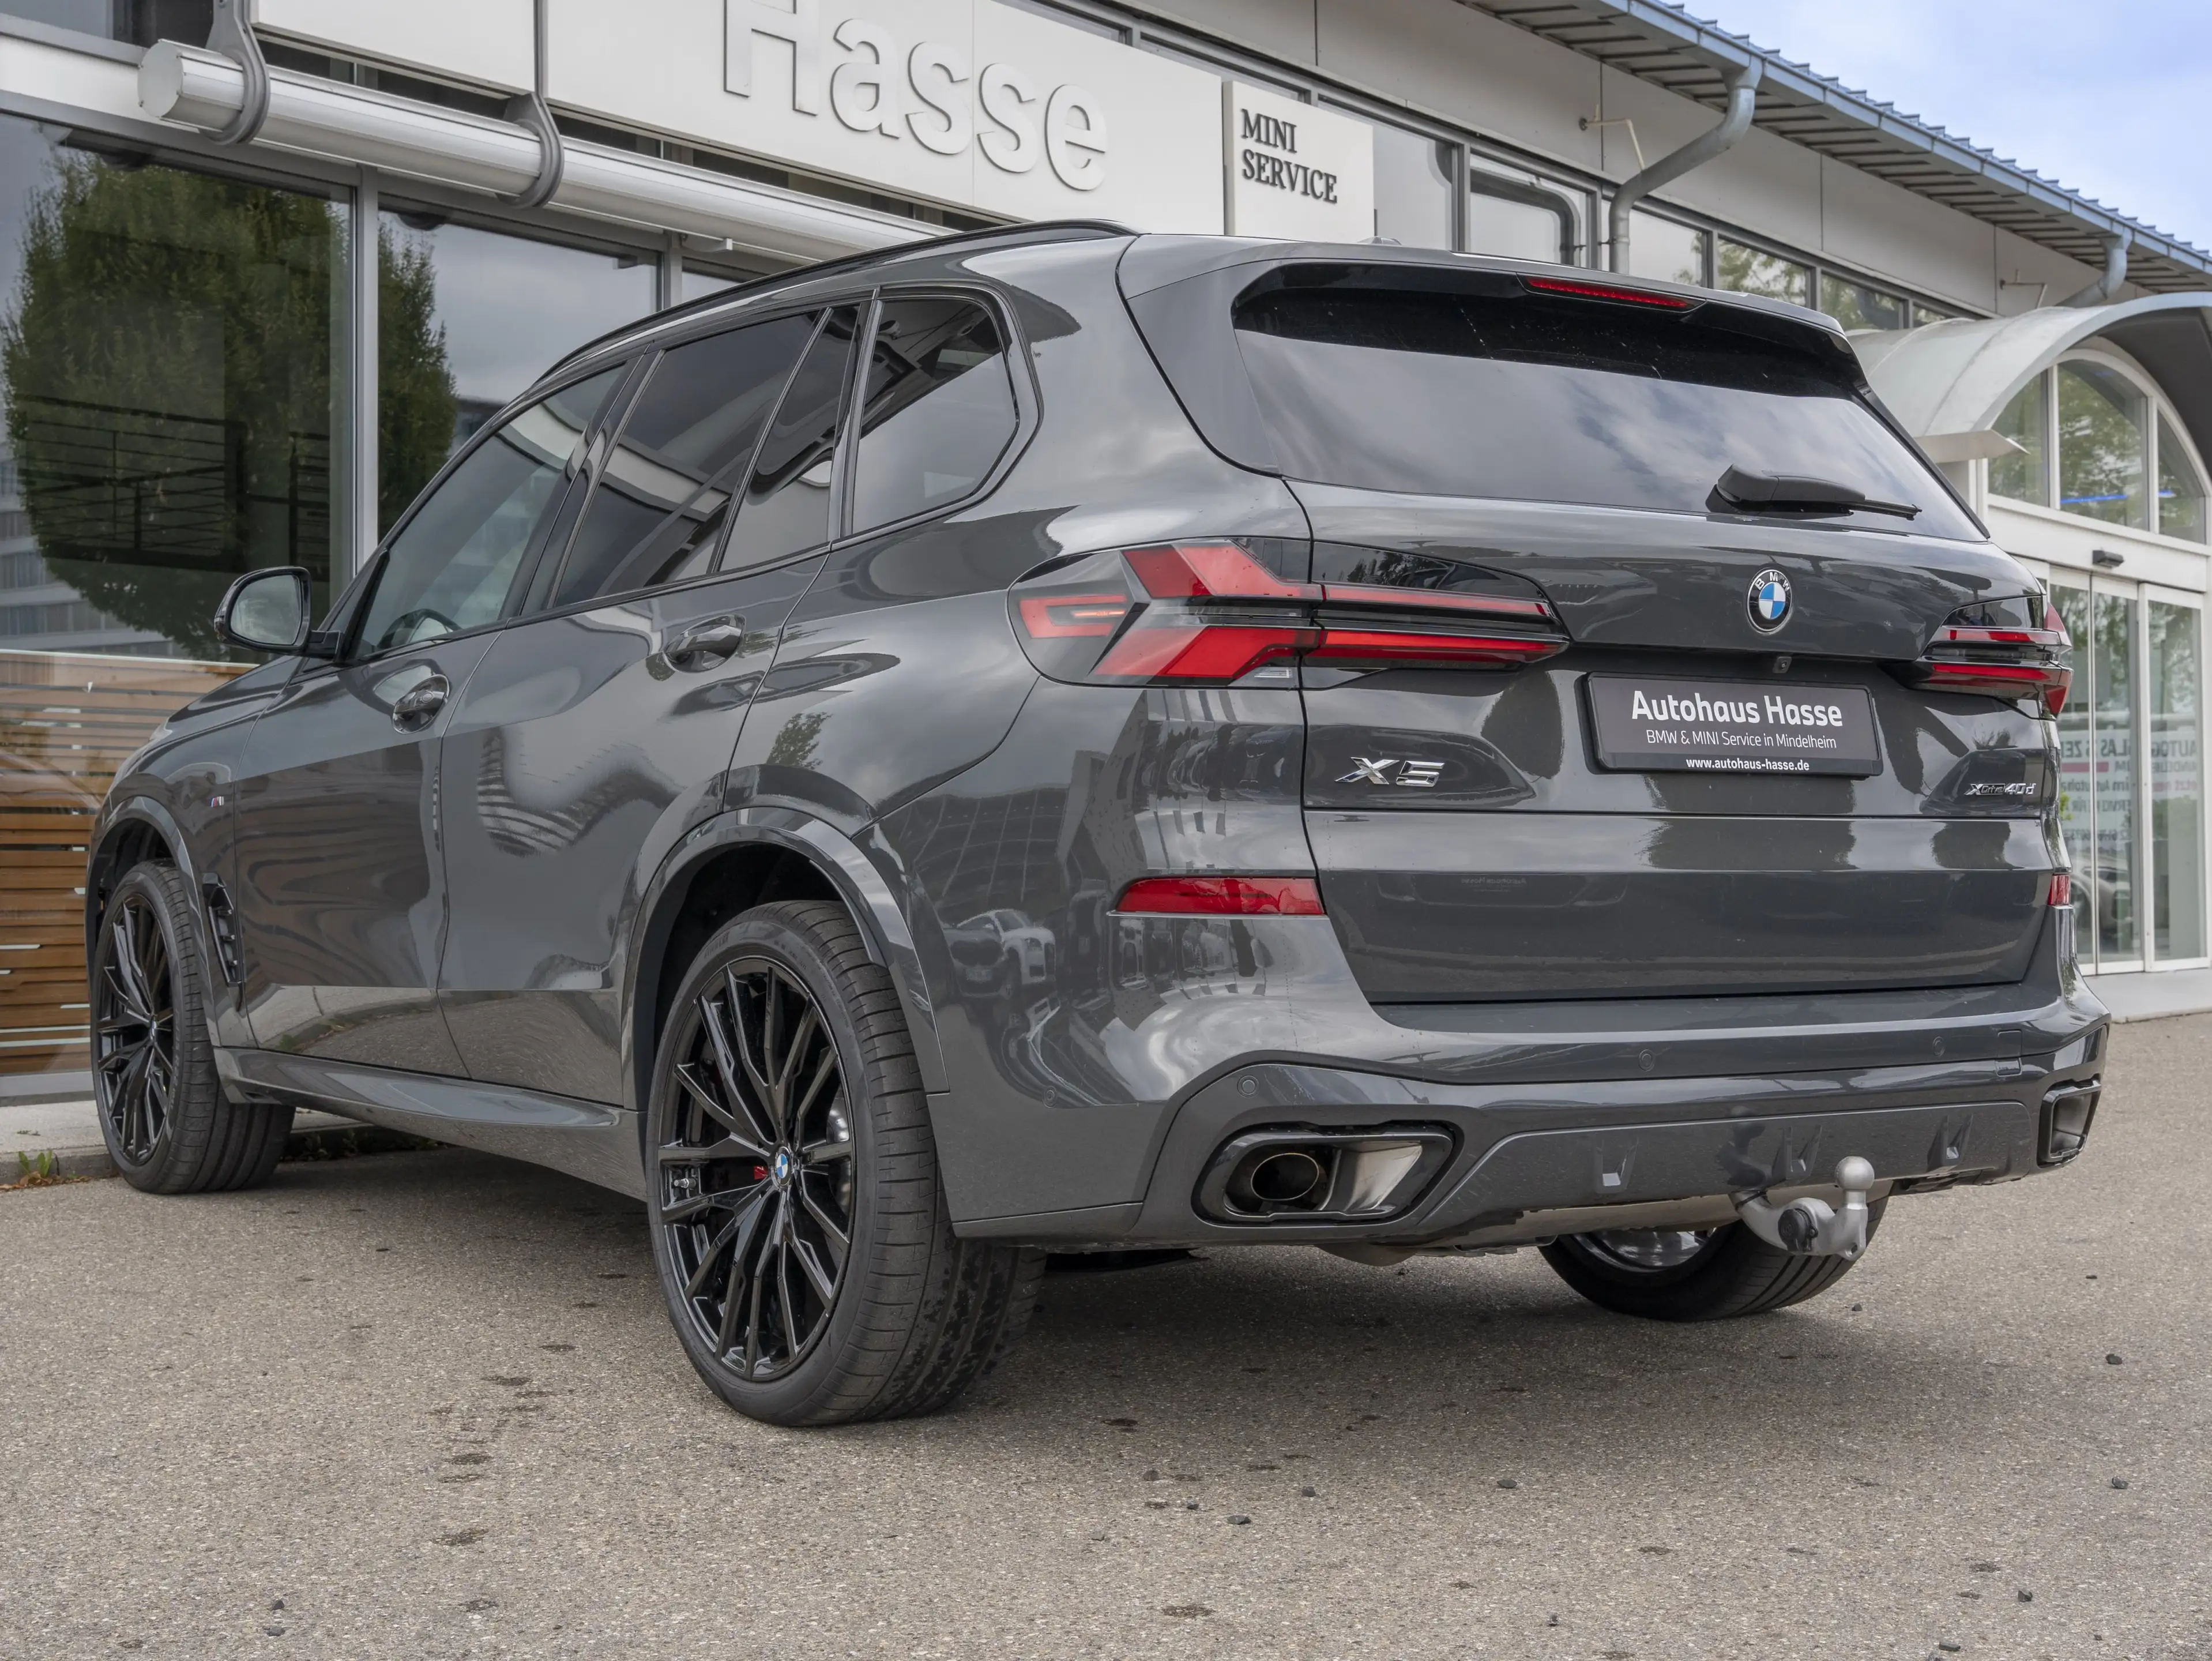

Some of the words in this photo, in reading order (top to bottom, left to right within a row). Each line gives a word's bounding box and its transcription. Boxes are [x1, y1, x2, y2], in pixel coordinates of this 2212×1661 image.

[723, 0, 1107, 191] Hasse
[1240, 108, 1297, 153] MINI
[1242, 149, 1338, 204] SERVICE
[1755, 572, 1790, 592] BMW
[1631, 690, 1760, 724] Autohaus
[1763, 695, 1843, 727] Hasse
[1646, 729, 1677, 744] BMW
[1681, 730, 1690, 744] &
[1692, 730, 1720, 745] MINI
[1722, 731, 1762, 746] Service
[1763, 732, 1774, 747] in
[1775, 733, 1837, 749] Mindelheim
[1334, 756, 1445, 787] X5
[1686, 756, 1810, 771] www.autohaus-hasse.de
